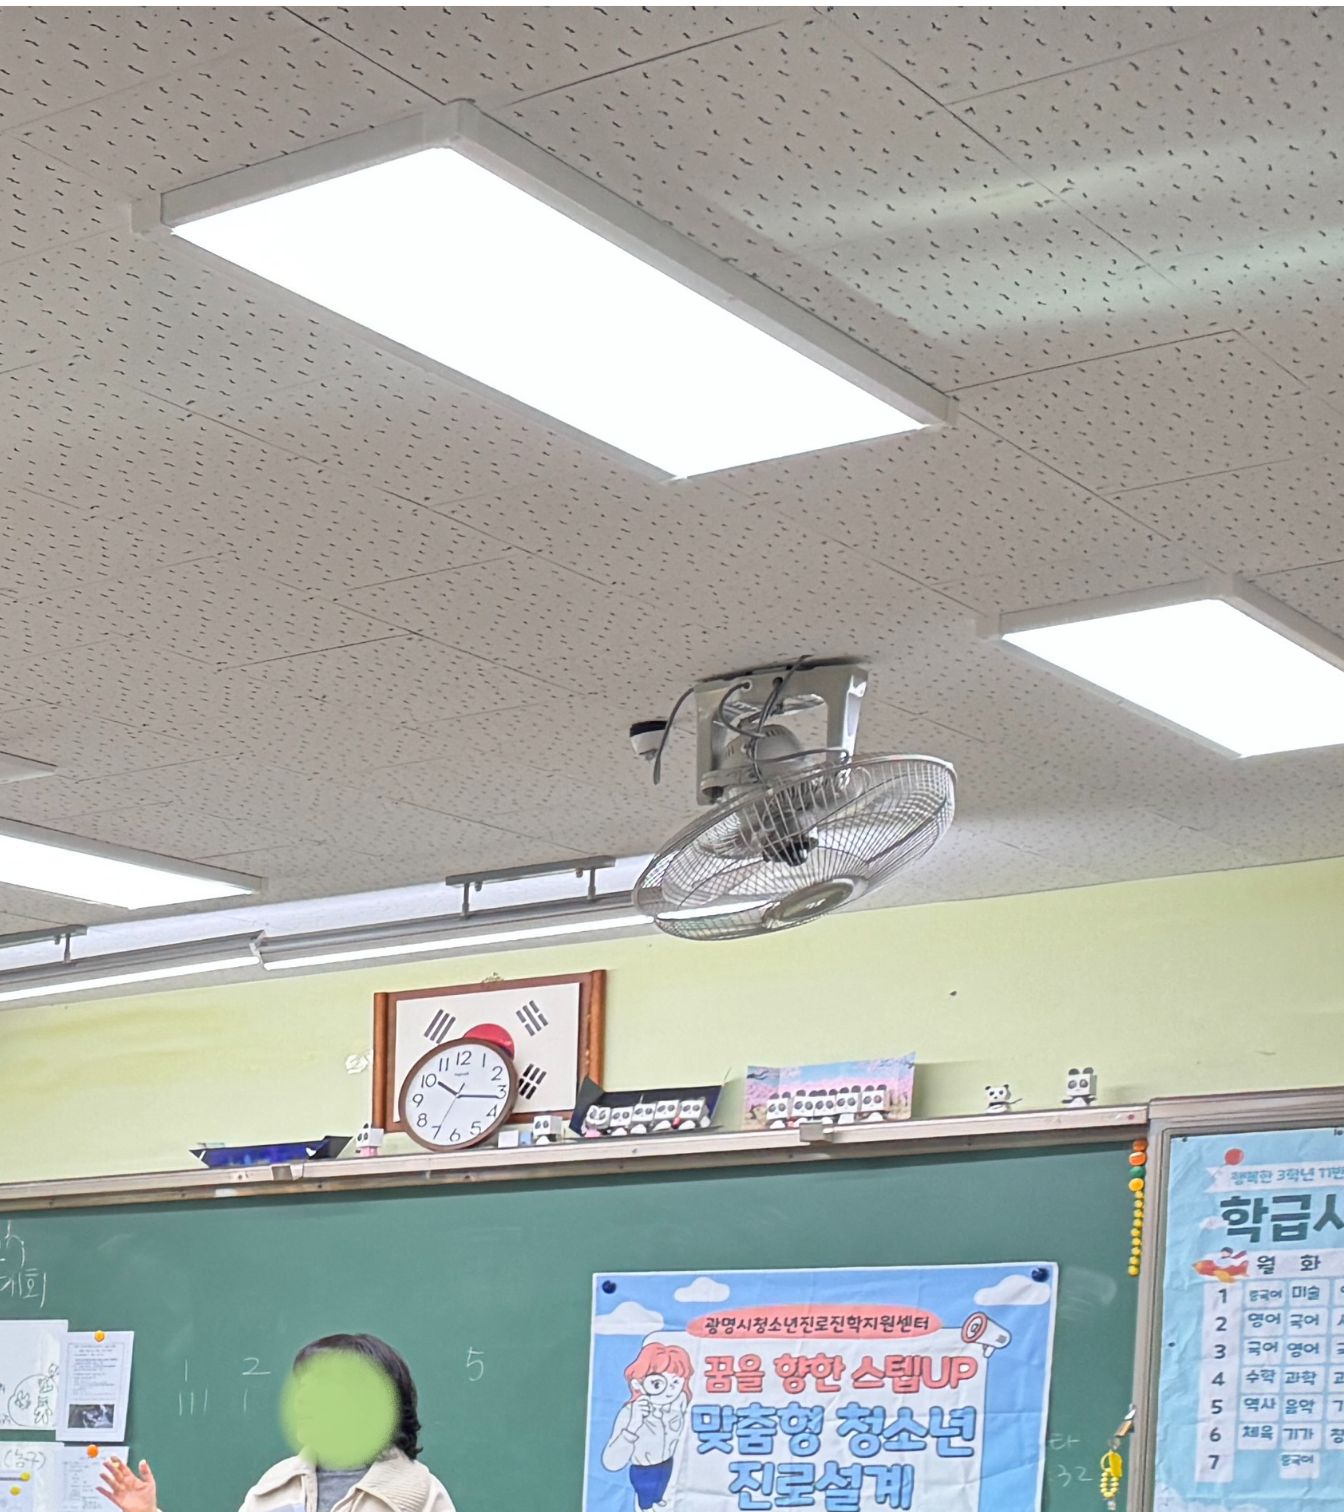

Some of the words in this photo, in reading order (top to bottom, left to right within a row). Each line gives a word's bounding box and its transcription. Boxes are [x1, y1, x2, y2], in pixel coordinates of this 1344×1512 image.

[438, 1057, 450, 1072] 11
[455, 1050, 472, 1066] 12
[420, 1073, 437, 1088] 10
[491, 1066, 503, 1081] 2
[412, 1093, 424, 1108] 9
[497, 1084, 507, 1100] 3
[486, 1104, 497, 1118] 4
[416, 1112, 428, 1128] 8
[470, 1120, 482, 1136] 5
[431, 1125, 442, 1140] 7
[449, 1128, 461, 1142] 6
[1231, 1169, 1273, 1186] 행복한
[1277, 1167, 1315, 1183] 3학년
[1257, 1255, 1276, 1275] 월
[1300, 1254, 1321, 1271] 화
[1218, 1288, 1228, 1304] 1
[1291, 1285, 1320, 1301] 미술
[704, 1315, 930, 1335] 광명시청소년진로진학지원센터
[1215, 1316, 1227, 1332] 2
[1248, 1312, 1281, 1328] 영어
[1289, 1313, 1320, 1329] 국어
[1213, 1344, 1226, 1359] 3
[1247, 1340, 1279, 1356] 국어
[1286, 1342, 1320, 1358] 영어
[241, 1356, 271, 1376] 2
[465, 1345, 485, 1382] 5
[704, 1353, 765, 1394] 꿈을
[773, 1352, 846, 1394] 향한
[851, 1353, 979, 1394] 스텝UP
[1211, 1371, 1225, 1386] 4
[1246, 1369, 1276, 1384] 수학
[1284, 1370, 1317, 1386] 과학
[1210, 1399, 1223, 1414] 5
[1243, 1397, 1276, 1412] 역사
[1284, 1398, 1315, 1414] 음악
[690, 1402, 824, 1456] 맞춤형
[835, 1401, 977, 1457] 청소년
[1209, 1427, 1222, 1442] 6
[1242, 1425, 1274, 1440] 체육
[1283, 1428, 1314, 1441] 기가
[1208, 1454, 1220, 1470] 7
[728, 1460, 915, 1512] 진로설계
